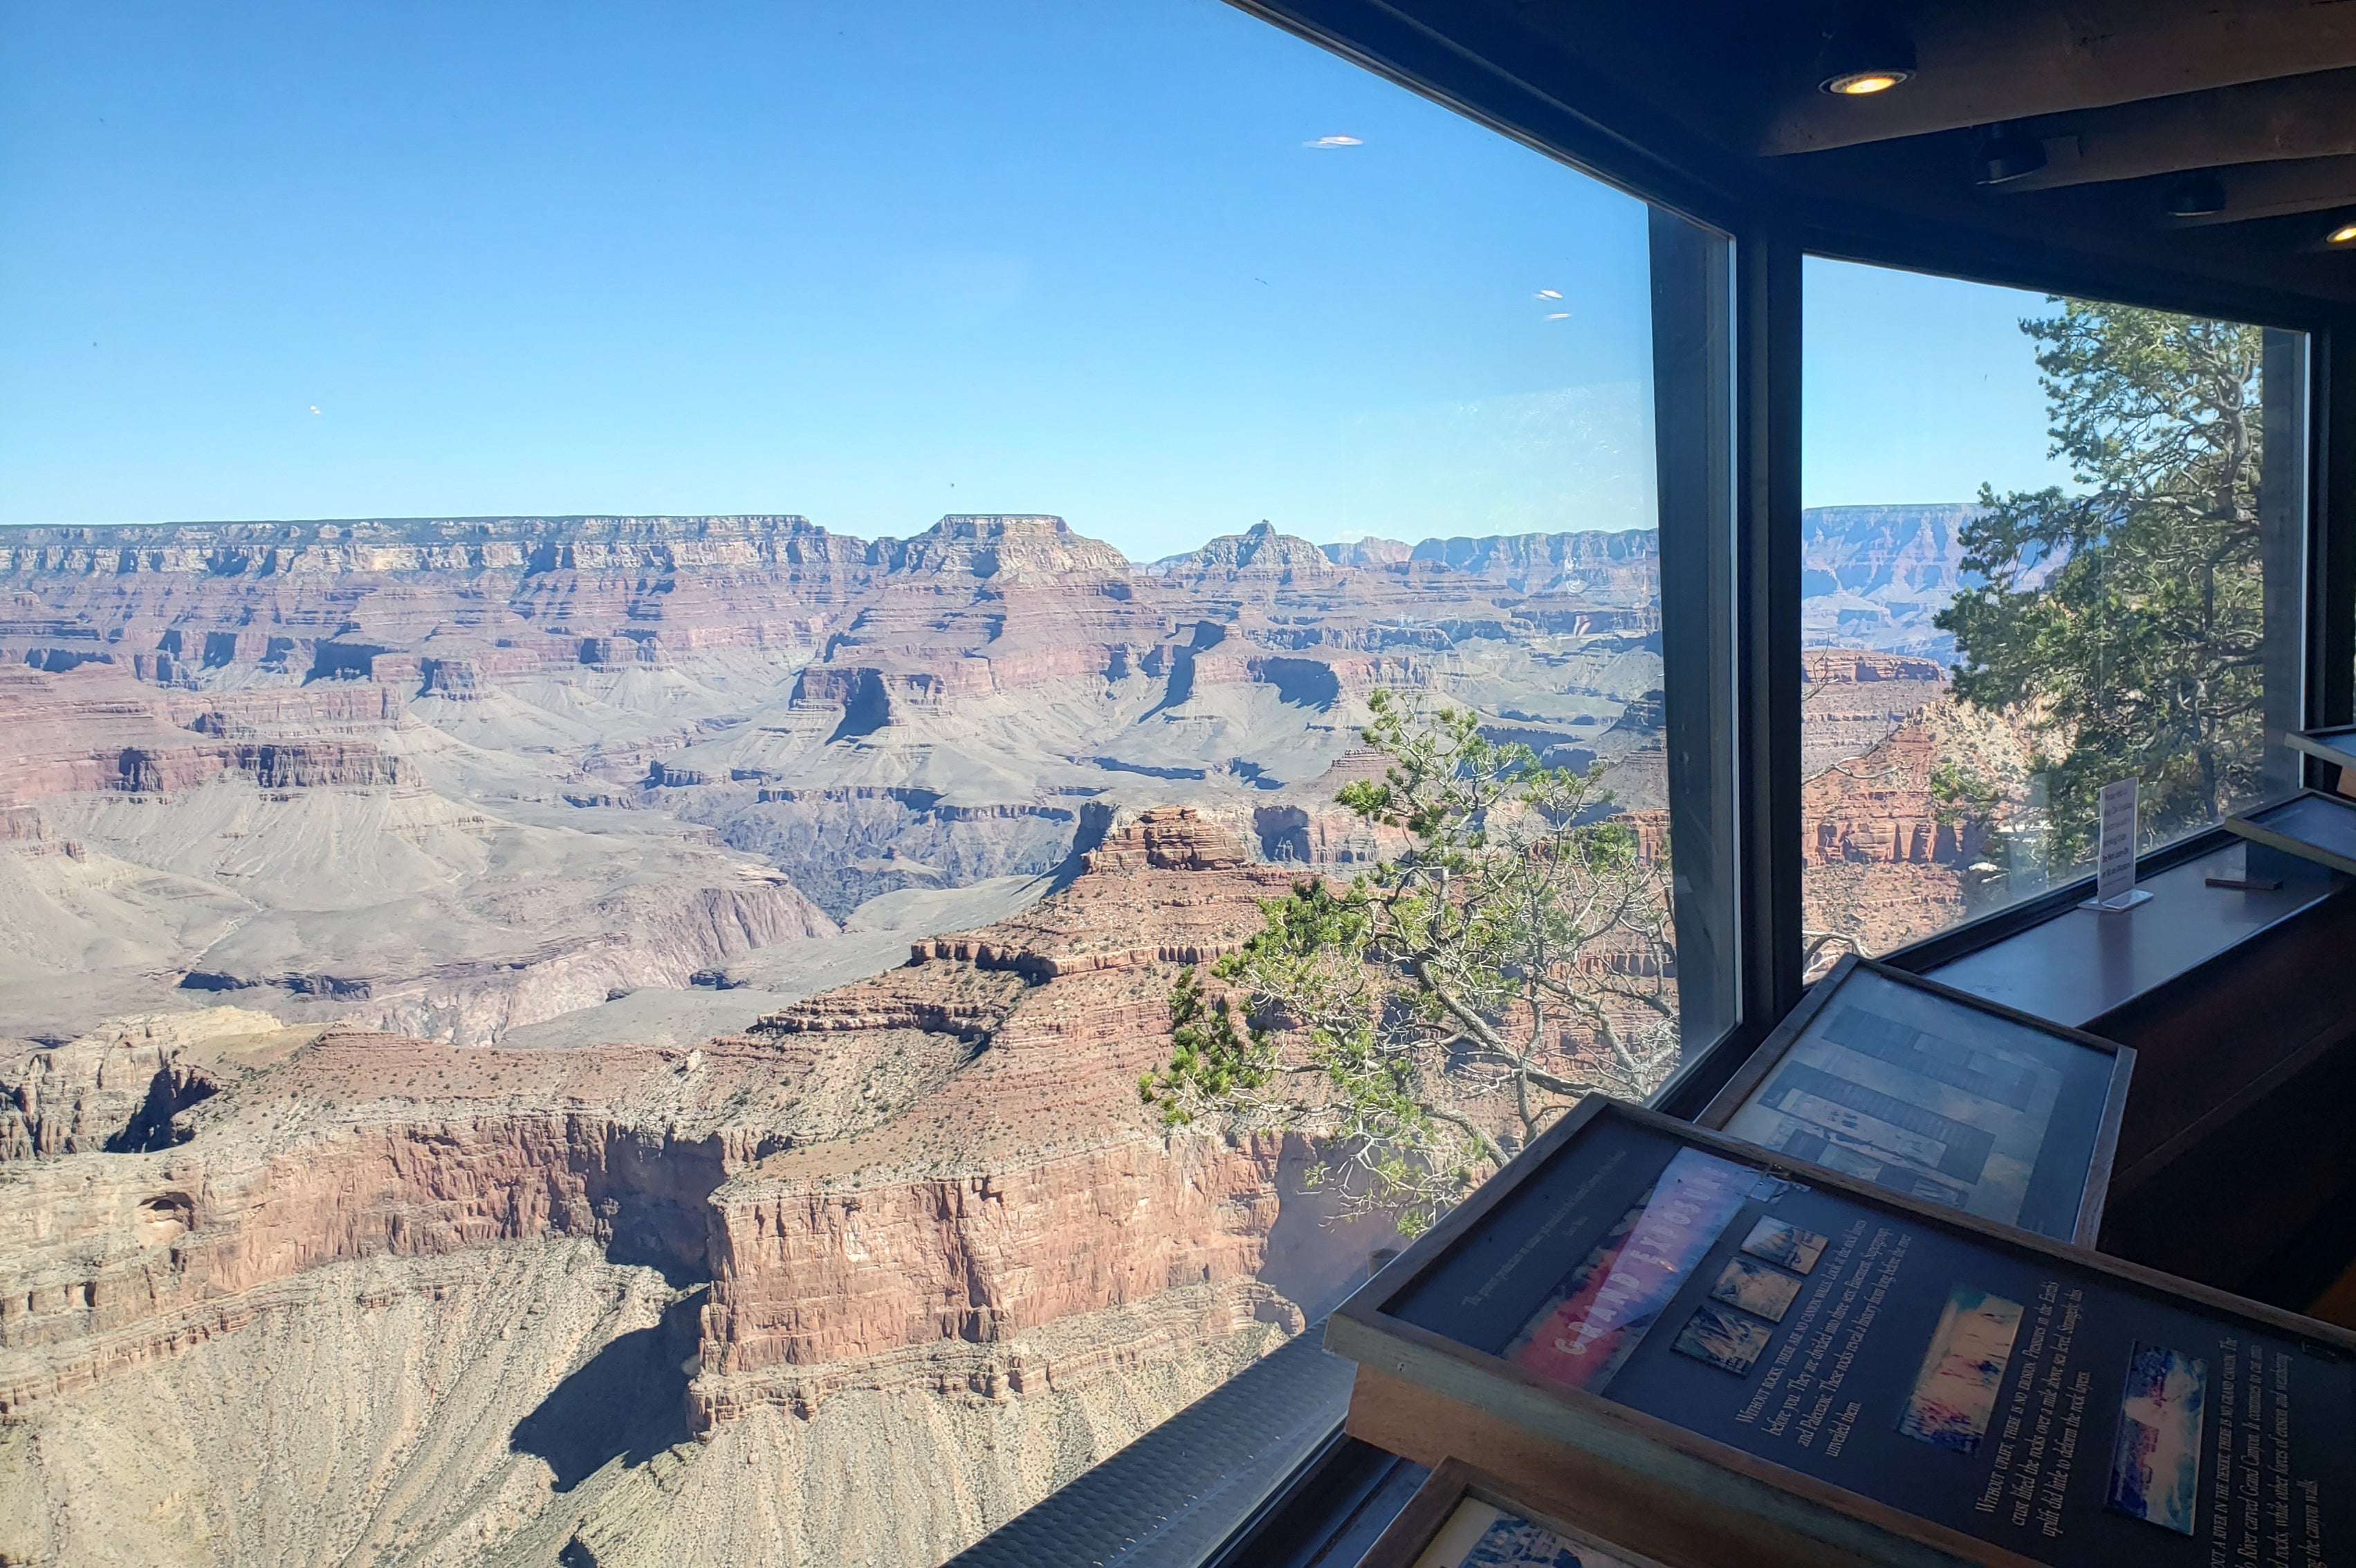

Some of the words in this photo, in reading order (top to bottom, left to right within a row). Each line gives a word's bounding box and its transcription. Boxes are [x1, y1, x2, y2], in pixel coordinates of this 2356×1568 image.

[1554, 1273, 1640, 1355] GRAND
[1629, 1166, 1729, 1266] EXPOSURE
[1888, 1247, 1906, 1257] the
[1820, 1263, 1842, 1280] Look
[1878, 1257, 1900, 1275] before
[1871, 1275, 1896, 1289] long
[2039, 1281, 2059, 1302] Earth's
[1863, 1288, 1885, 1304] from
[2064, 1289, 2082, 1301] this
[1827, 1302, 1849, 1319] three
[1851, 1303, 1881, 1327] history
[2033, 1304, 2052, 1316] the
[1794, 1322, 1808, 1333] NO
[1821, 1320, 1840, 1334] into
[2038, 1317, 2048, 1325] in
[1787, 1331, 1803, 1346] ARE
[1805, 1331, 1832, 1359] divided
[1846, 1329, 1864, 1352] reveal
[2022, 1326, 2045, 1358] Pressures
[2219, 1337, 2238, 1351] The
[1775, 1345, 1796, 1365] THERE
[1833, 1351, 1854, 1371] rocks
[2053, 1354, 2066, 1366] sea
[1804, 1359, 1819, 1372] are
[1762, 1367, 1786, 1389] ROCKS,
[1787, 1372, 1816, 1391] They
[1819, 1370, 1844, 1392] These
[2041, 1367, 2063, 1389] above
[2249, 1374, 2261, 1385] to
[2014, 1392, 2027, 1404] NO
[2038, 1390, 2057, 1408] mile
[2065, 1394, 2084, 1412] rock
[2222, 1381, 2234, 1405] GRAND
[2249, 1384, 2261, 1421] continues
[2272, 1390, 2288, 1408] and
[2060, 1413, 2081, 1427] the
[2220, 1405, 2233, 1417] NO
[1761, 1410, 1791, 1435] before
[2003, 1415, 2021, 1439] THERE
[2036, 1414, 2050, 1434] over
[2220, 1418, 2232, 1427] IS
[2274, 1409, 2288, 1438] erosion
[1795, 1427, 1814, 1446] and
[1825, 1421, 1850, 1456] unveiled
[2053, 1428, 2077, 1458] deform
[2219, 1427, 2231, 1450] THERE
[2270, 1436, 2288, 1448] of
[1994, 1442, 2016, 1469] UPLIFT,
[2025, 1435, 2045, 1459] rocks
[2018, 1459, 2039, 1475] the
[2056, 1459, 2070, 1469] to
[2270, 1449, 2288, 1475] forces
[2010, 1473, 2035, 1500] lifted
[2044, 1470, 2068, 1491] little
[2240, 1466, 2258, 1496] Grand
[2270, 1475, 2288, 1500] other
[2041, 1490, 2063, 1509] did
[2216, 1483, 2229, 1500] THE
[2012, 1501, 2029, 1525] crust
[2215, 1501, 2227, 1513] IN
[2238, 1496, 2258, 1530] carved
[2269, 1502, 2288, 1527] while
[2036, 1509, 2063, 1536] uplift
[2214, 1514, 2227, 1540] RIVER
[2306, 1504, 2324, 1538] canyon
[2213, 1542, 2225, 1550] A
[2237, 1531, 2257, 1560] River
[2267, 1531, 2290, 1560] rocks,
[2301, 1540, 2320, 1557] the
